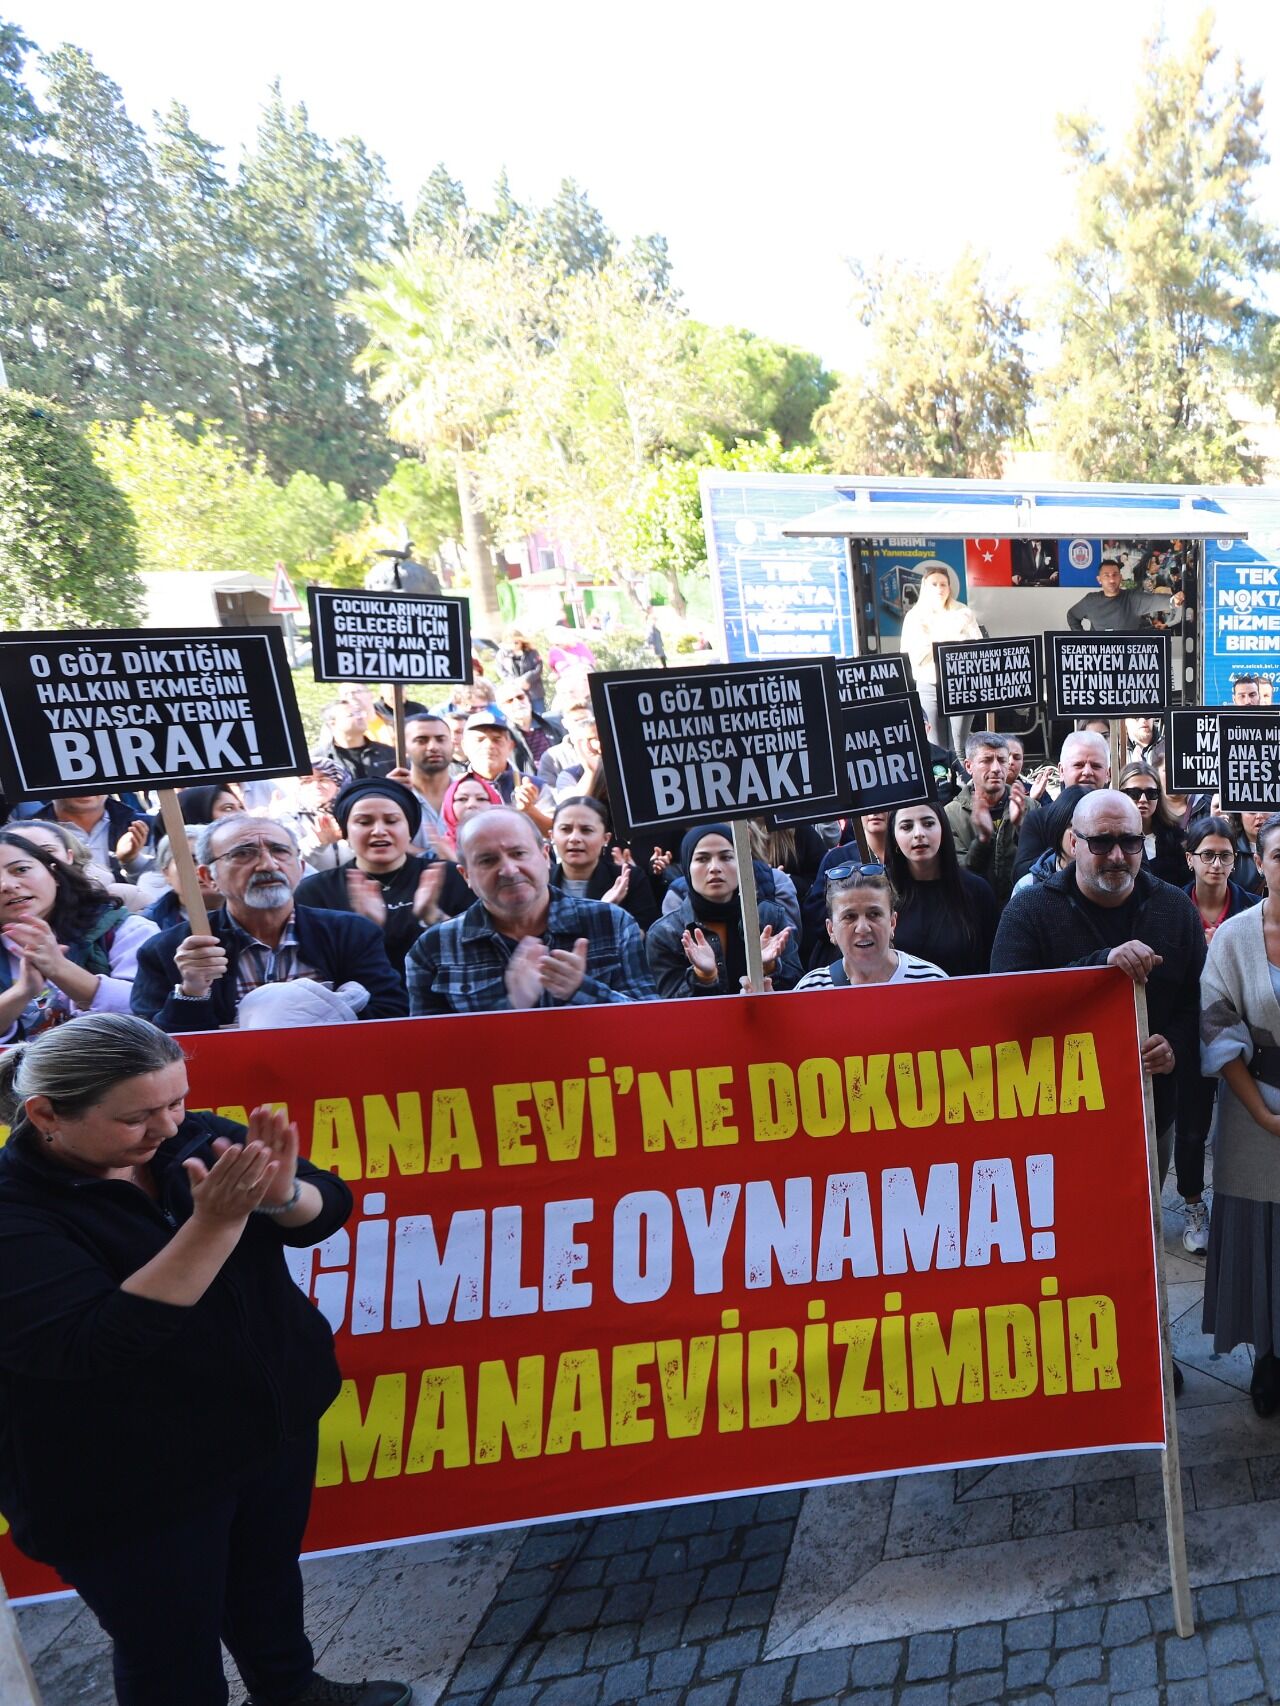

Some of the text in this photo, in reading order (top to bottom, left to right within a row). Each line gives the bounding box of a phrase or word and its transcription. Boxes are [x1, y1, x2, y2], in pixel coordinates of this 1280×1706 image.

[1236, 568, 1279, 585] TEK
[333, 599, 447, 617] ÇOCUKLARIMIZIN
[334, 616, 448, 637] GELECEĞİ İÇİN
[336, 634, 449, 650] MERYEM ANA EVİ
[1061, 644, 1159, 655] SEZAR'IN HAKKI SEZAR'A
[30, 643, 242, 678] O GÖZ DİKTİĞİN
[337, 648, 450, 677] BİZİMDİR
[945, 646, 1030, 661] SEZAR'IN HAKKI SEZAR'A
[1061, 654, 1159, 671] MERYEM ANA
[870, 663, 899, 680] ANA
[946, 654, 1031, 676] MERYEM ANA
[36, 671, 248, 704] HALKIN EKMEĞİNİ
[947, 670, 1031, 692] EVİ'NİN HAKKI
[1062, 671, 1113, 690] EVİ'NİN
[1117, 673, 1160, 690] HAKKI
[638, 675, 801, 715] O GÖZ DİKTİĞİN
[948, 684, 1032, 705] EFES SELÇUK'A
[1063, 690, 1160, 707] EFES SELÇUK'A
[166, 699, 251, 723] YERİNE
[642, 702, 804, 741] HALKIN EKMEĞİNİ
[741, 729, 807, 755] YERİNE
[845, 720, 911, 751] ANA EVİ
[1228, 726, 1262, 740] DÜNYA
[50, 721, 263, 781] BIRAK!
[1229, 745, 1257, 759] ANA
[1229, 761, 1272, 781] EFES
[651, 752, 812, 816] BIRAK!
[309, 1032, 1105, 1181] ANA EVİ'NE DOKUNMA
[613, 1153, 1056, 1304] OYNAMA!
